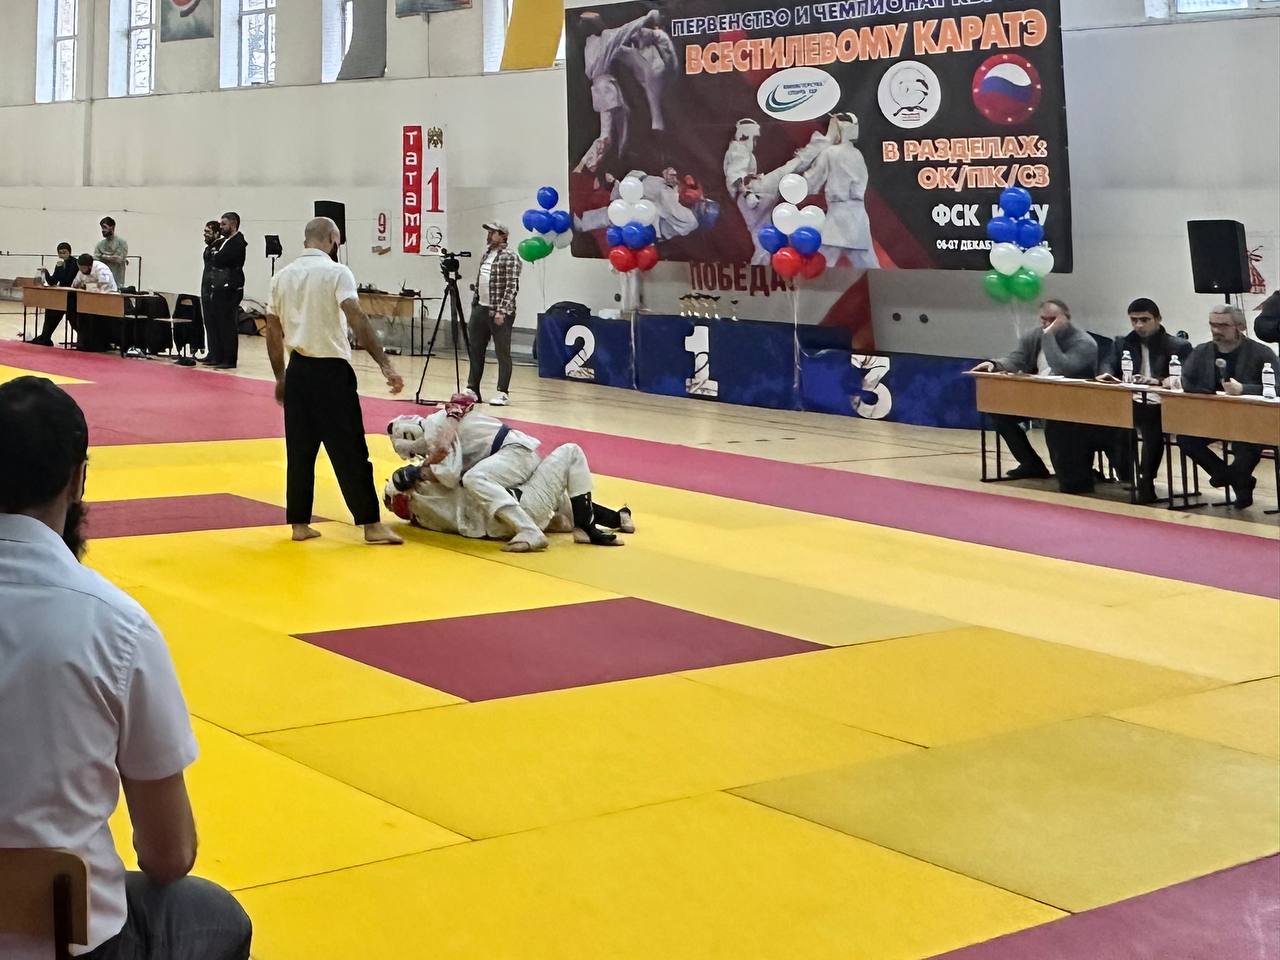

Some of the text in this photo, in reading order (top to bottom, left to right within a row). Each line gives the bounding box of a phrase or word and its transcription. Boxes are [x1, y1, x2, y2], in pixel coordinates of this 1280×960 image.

[671, 7, 791, 37] ПЕРВЕНСТВО
[794, 5, 810, 26] И
[685, 8, 1047, 75] ВСЕСТИЛЕВОМУ КАРАТЭ
[882, 135, 1048, 163] В РАЗДЕЛАХ:
[426, 167, 444, 212] 1
[931, 203, 980, 227] ФСК
[564, 324, 893, 420] 2 1 3
